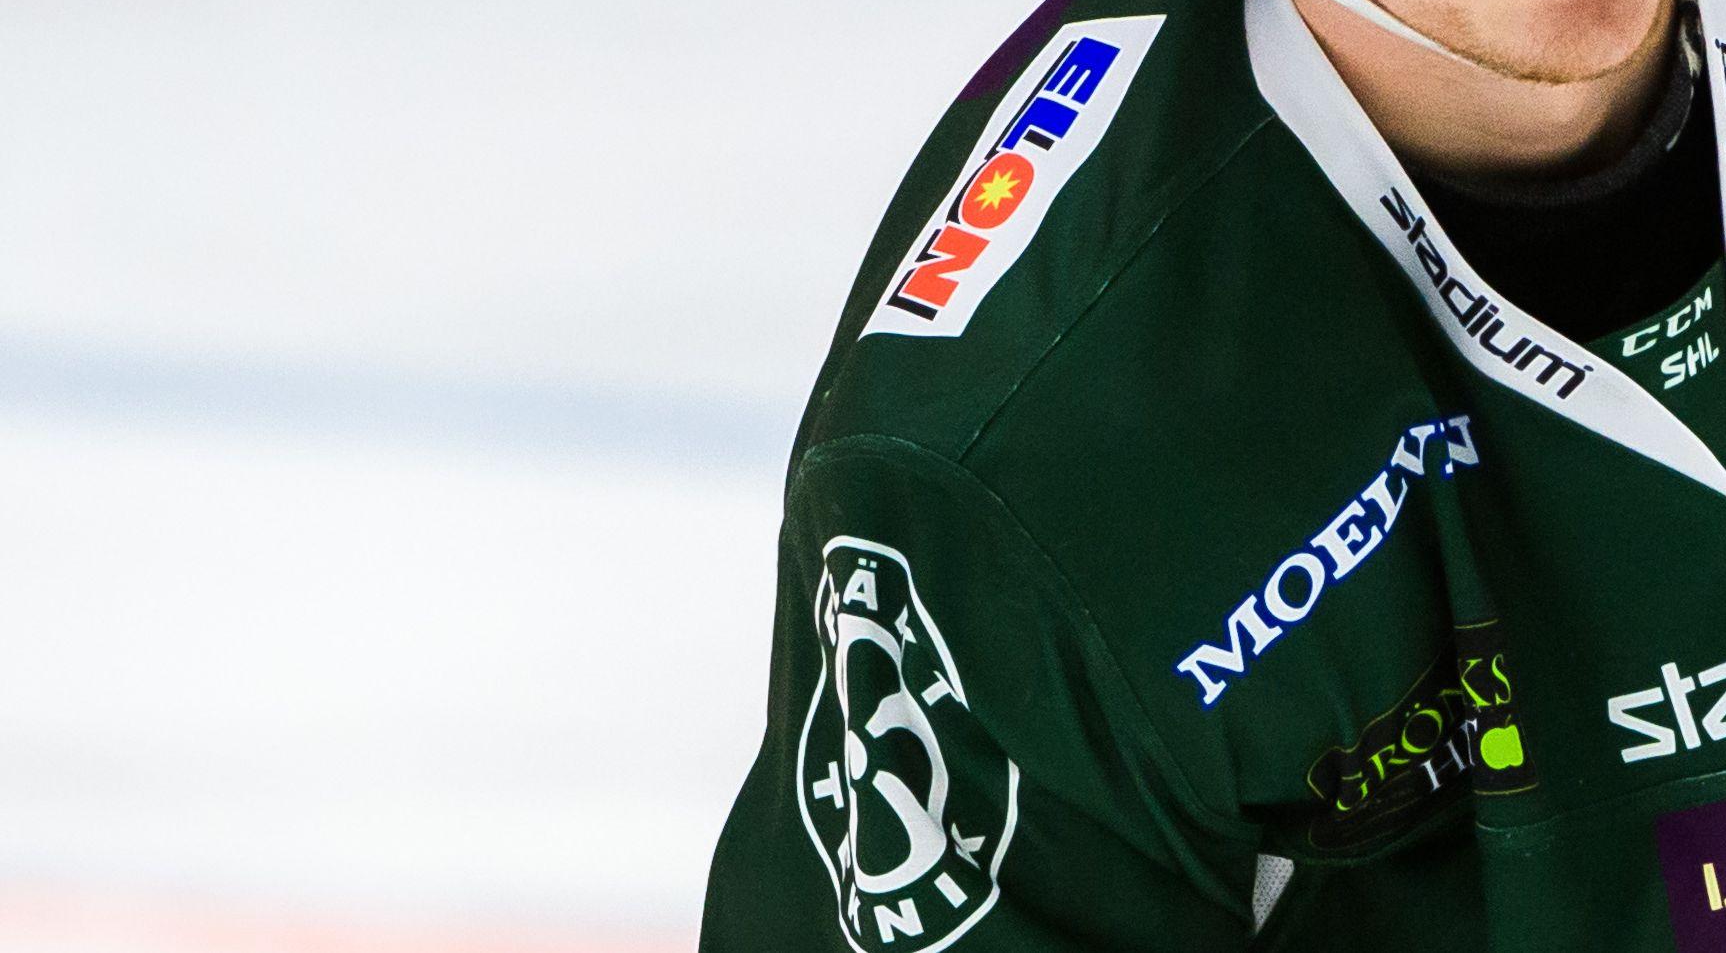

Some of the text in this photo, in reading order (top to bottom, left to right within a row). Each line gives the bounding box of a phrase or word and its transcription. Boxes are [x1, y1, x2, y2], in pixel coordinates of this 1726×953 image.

[886, 36, 1121, 322] ELON
[1379, 186, 1594, 400] stadium
[1621, 286, 1713, 357] CCM
[1660, 331, 1720, 390] SHL
